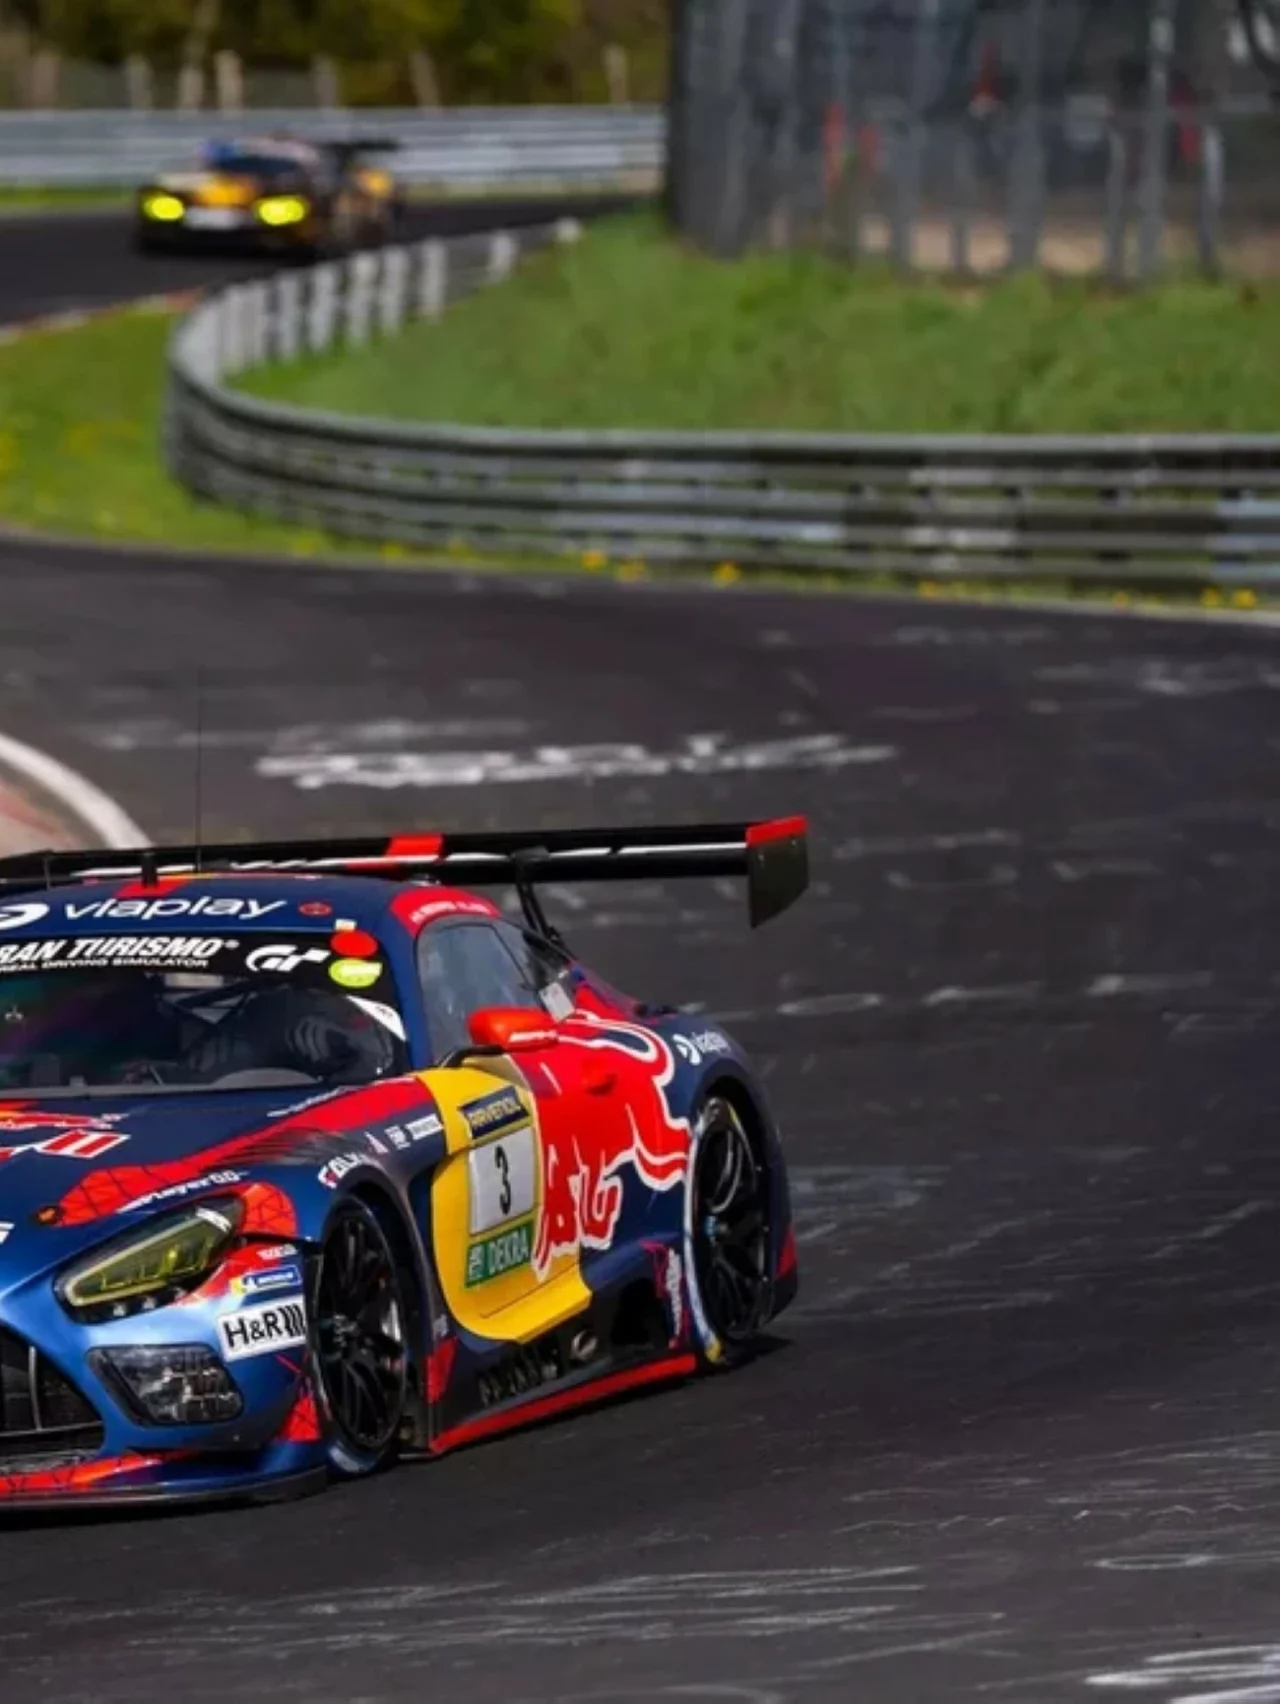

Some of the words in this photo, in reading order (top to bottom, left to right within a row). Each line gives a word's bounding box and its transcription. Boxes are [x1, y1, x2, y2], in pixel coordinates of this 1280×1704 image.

[64, 896, 290, 920] viaplay
[41, 957, 109, 969] DRIVING
[112, 956, 210, 968] SIMULATOR
[66, 937, 224, 959] TURISMO
[494, 1144, 512, 1215] 3
[488, 1227, 529, 1276] DEKRA
[222, 1308, 283, 1348] H&R
